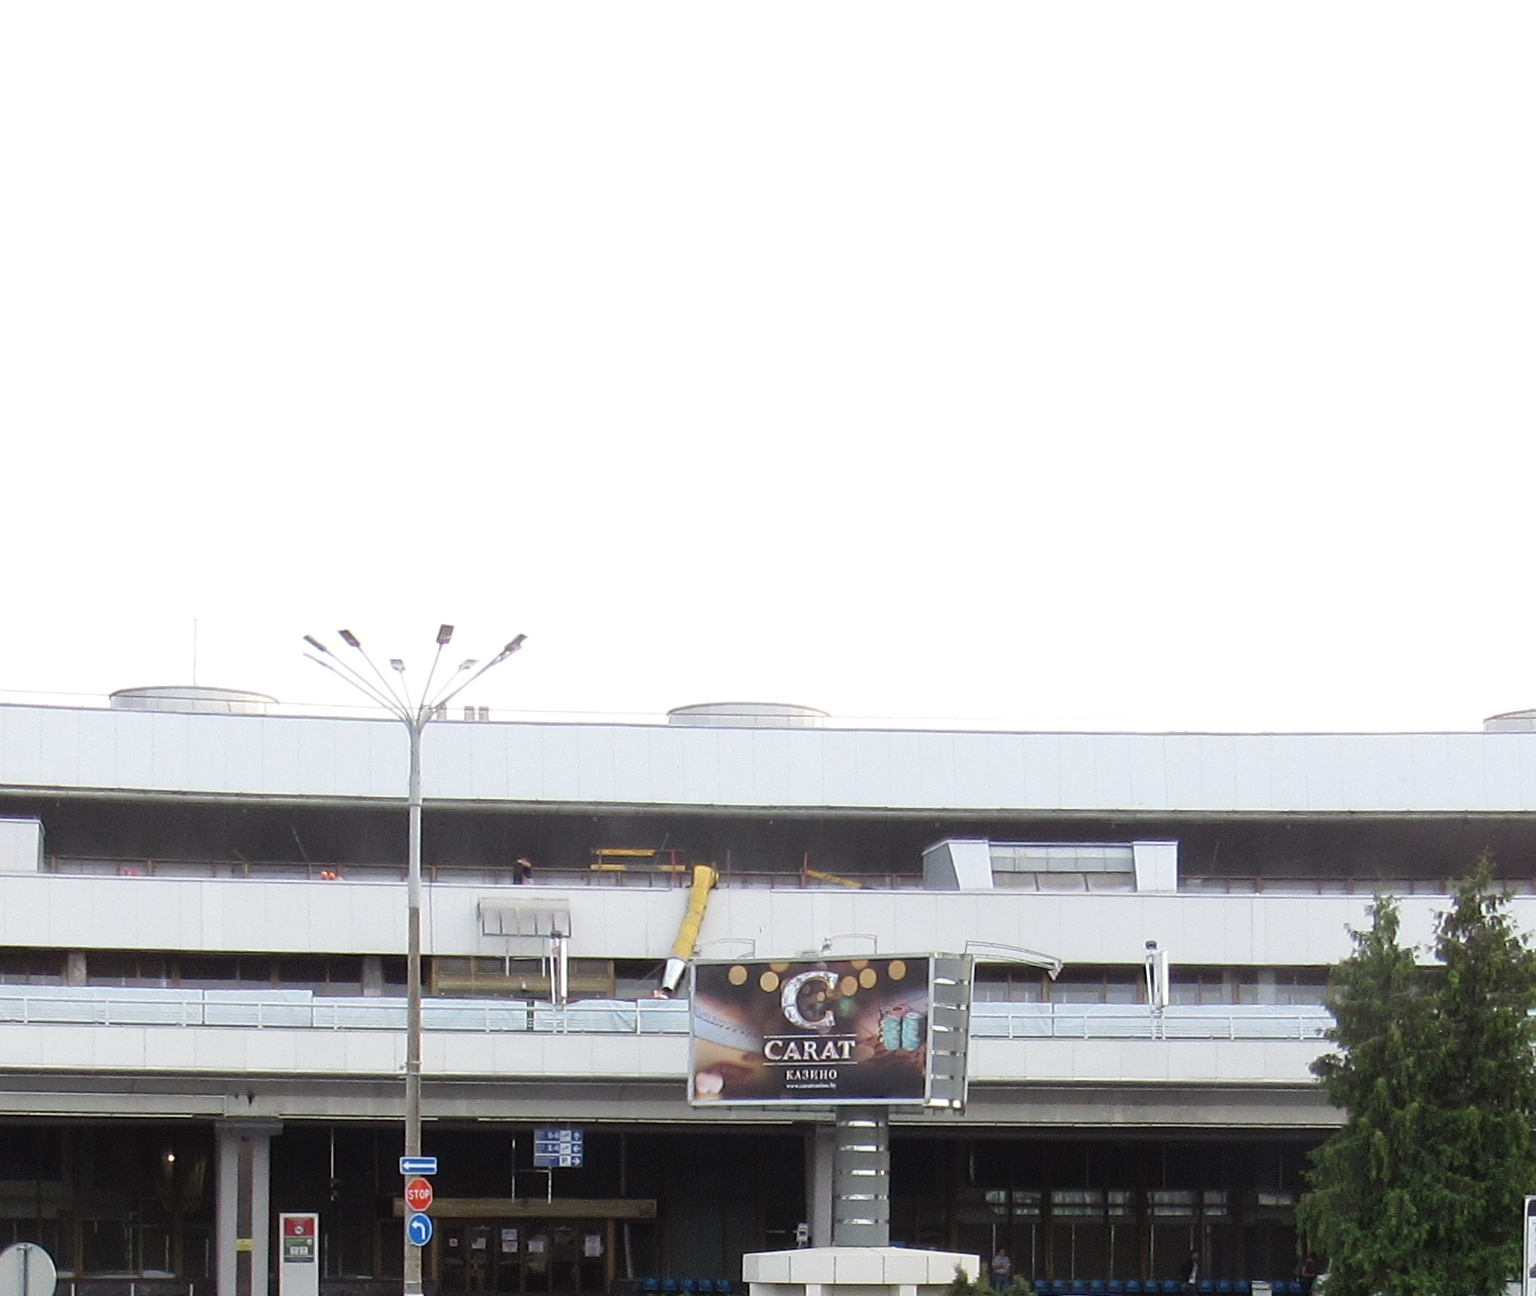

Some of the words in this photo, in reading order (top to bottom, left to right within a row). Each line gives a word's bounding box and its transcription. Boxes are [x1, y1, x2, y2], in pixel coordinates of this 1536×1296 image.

[763, 1040, 856, 1061] CARAT
[785, 1069, 838, 1081] КАЗИНО
[408, 1189, 431, 1200] STOP
